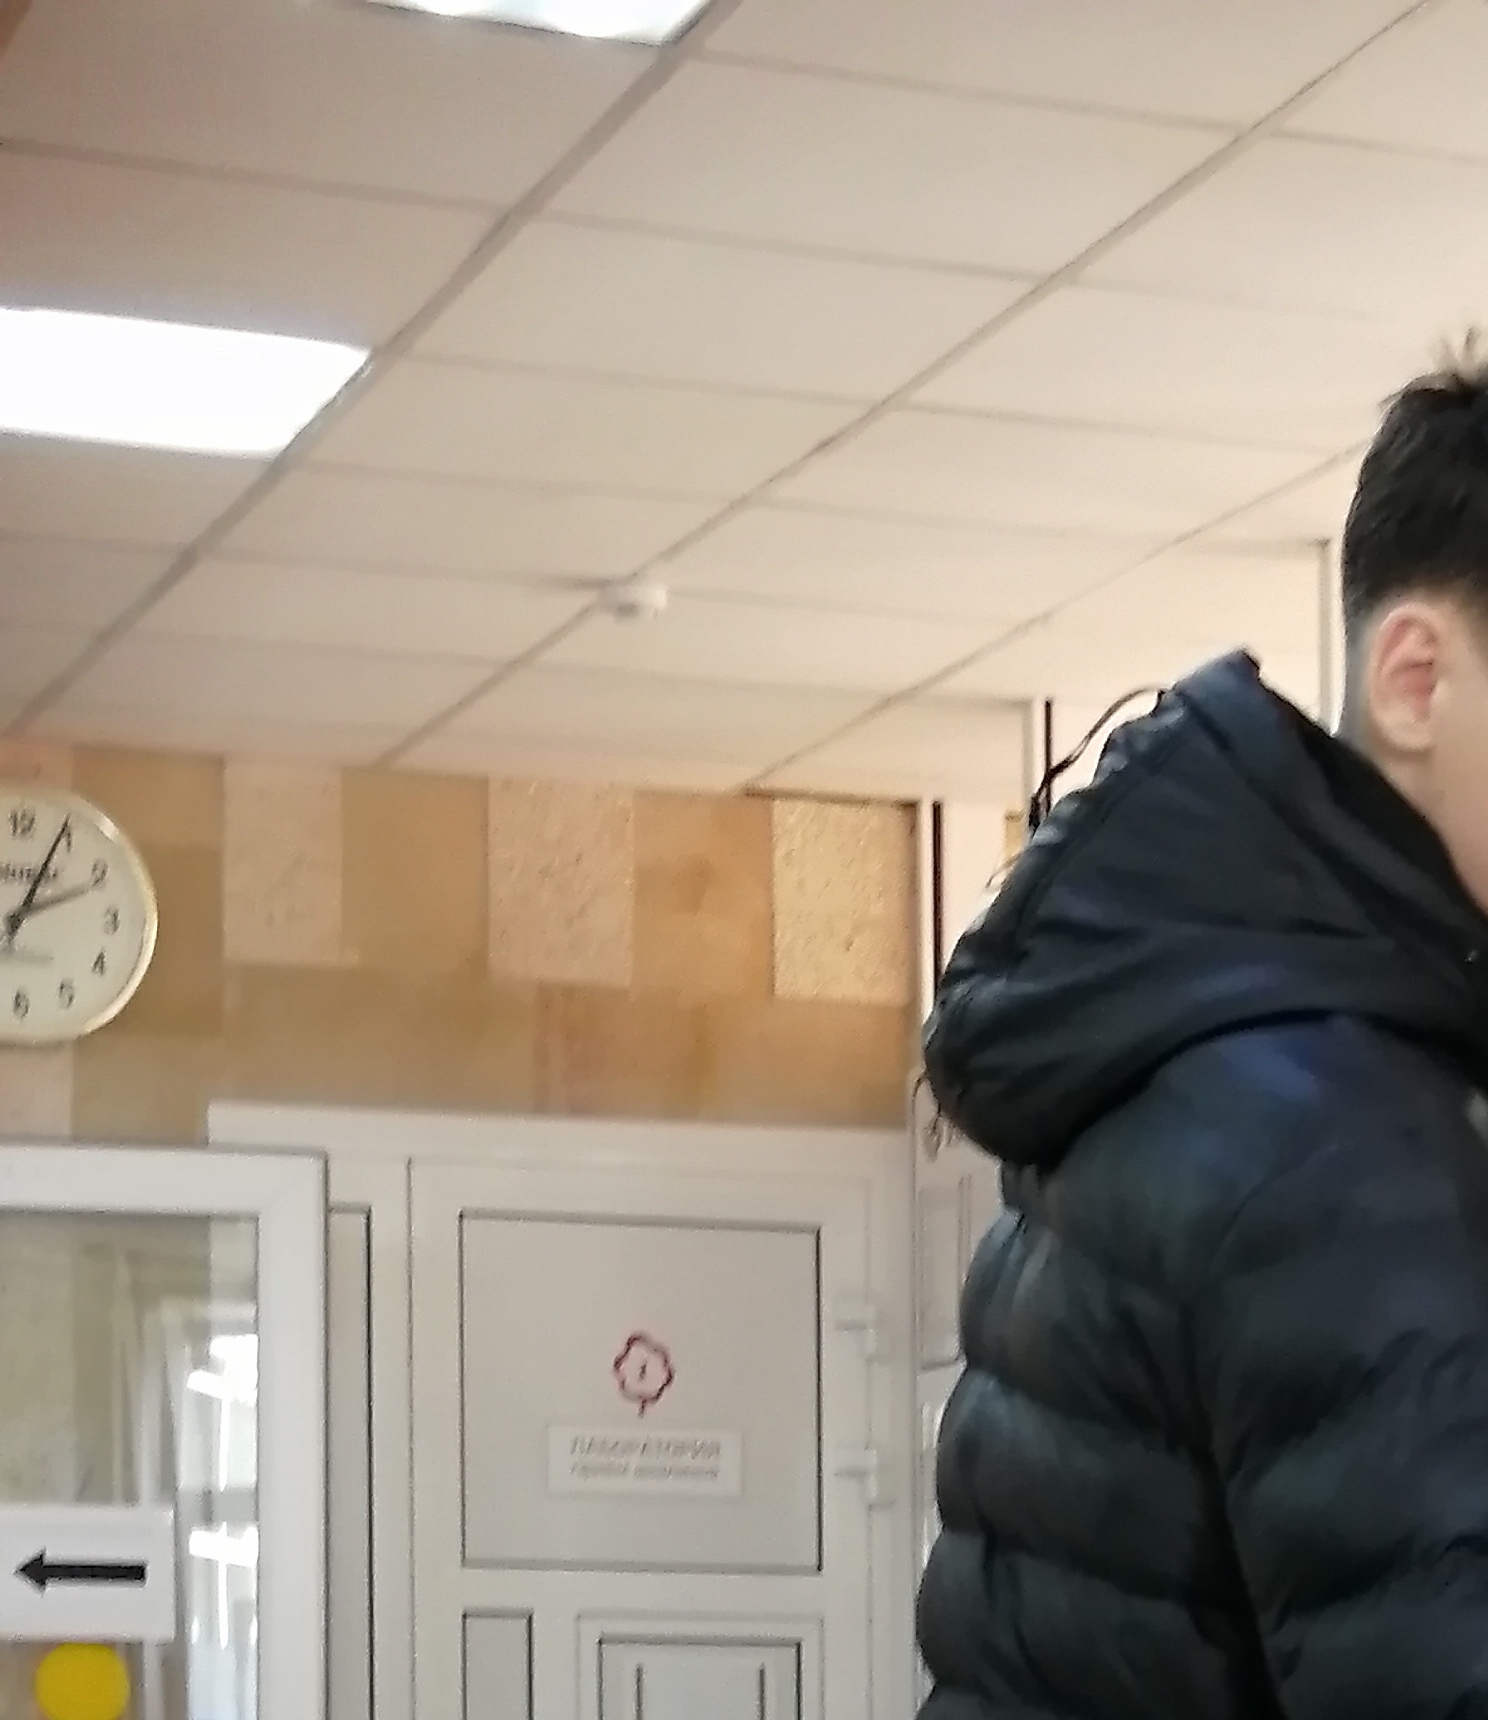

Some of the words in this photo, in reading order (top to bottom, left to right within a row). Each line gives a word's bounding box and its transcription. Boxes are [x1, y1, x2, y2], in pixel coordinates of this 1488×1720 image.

[8, 806, 37, 841] 12
[103, 904, 121, 936] 3
[90, 946, 108, 978] 4
[12, 987, 31, 1021] 6
[57, 977, 76, 1011] 5
